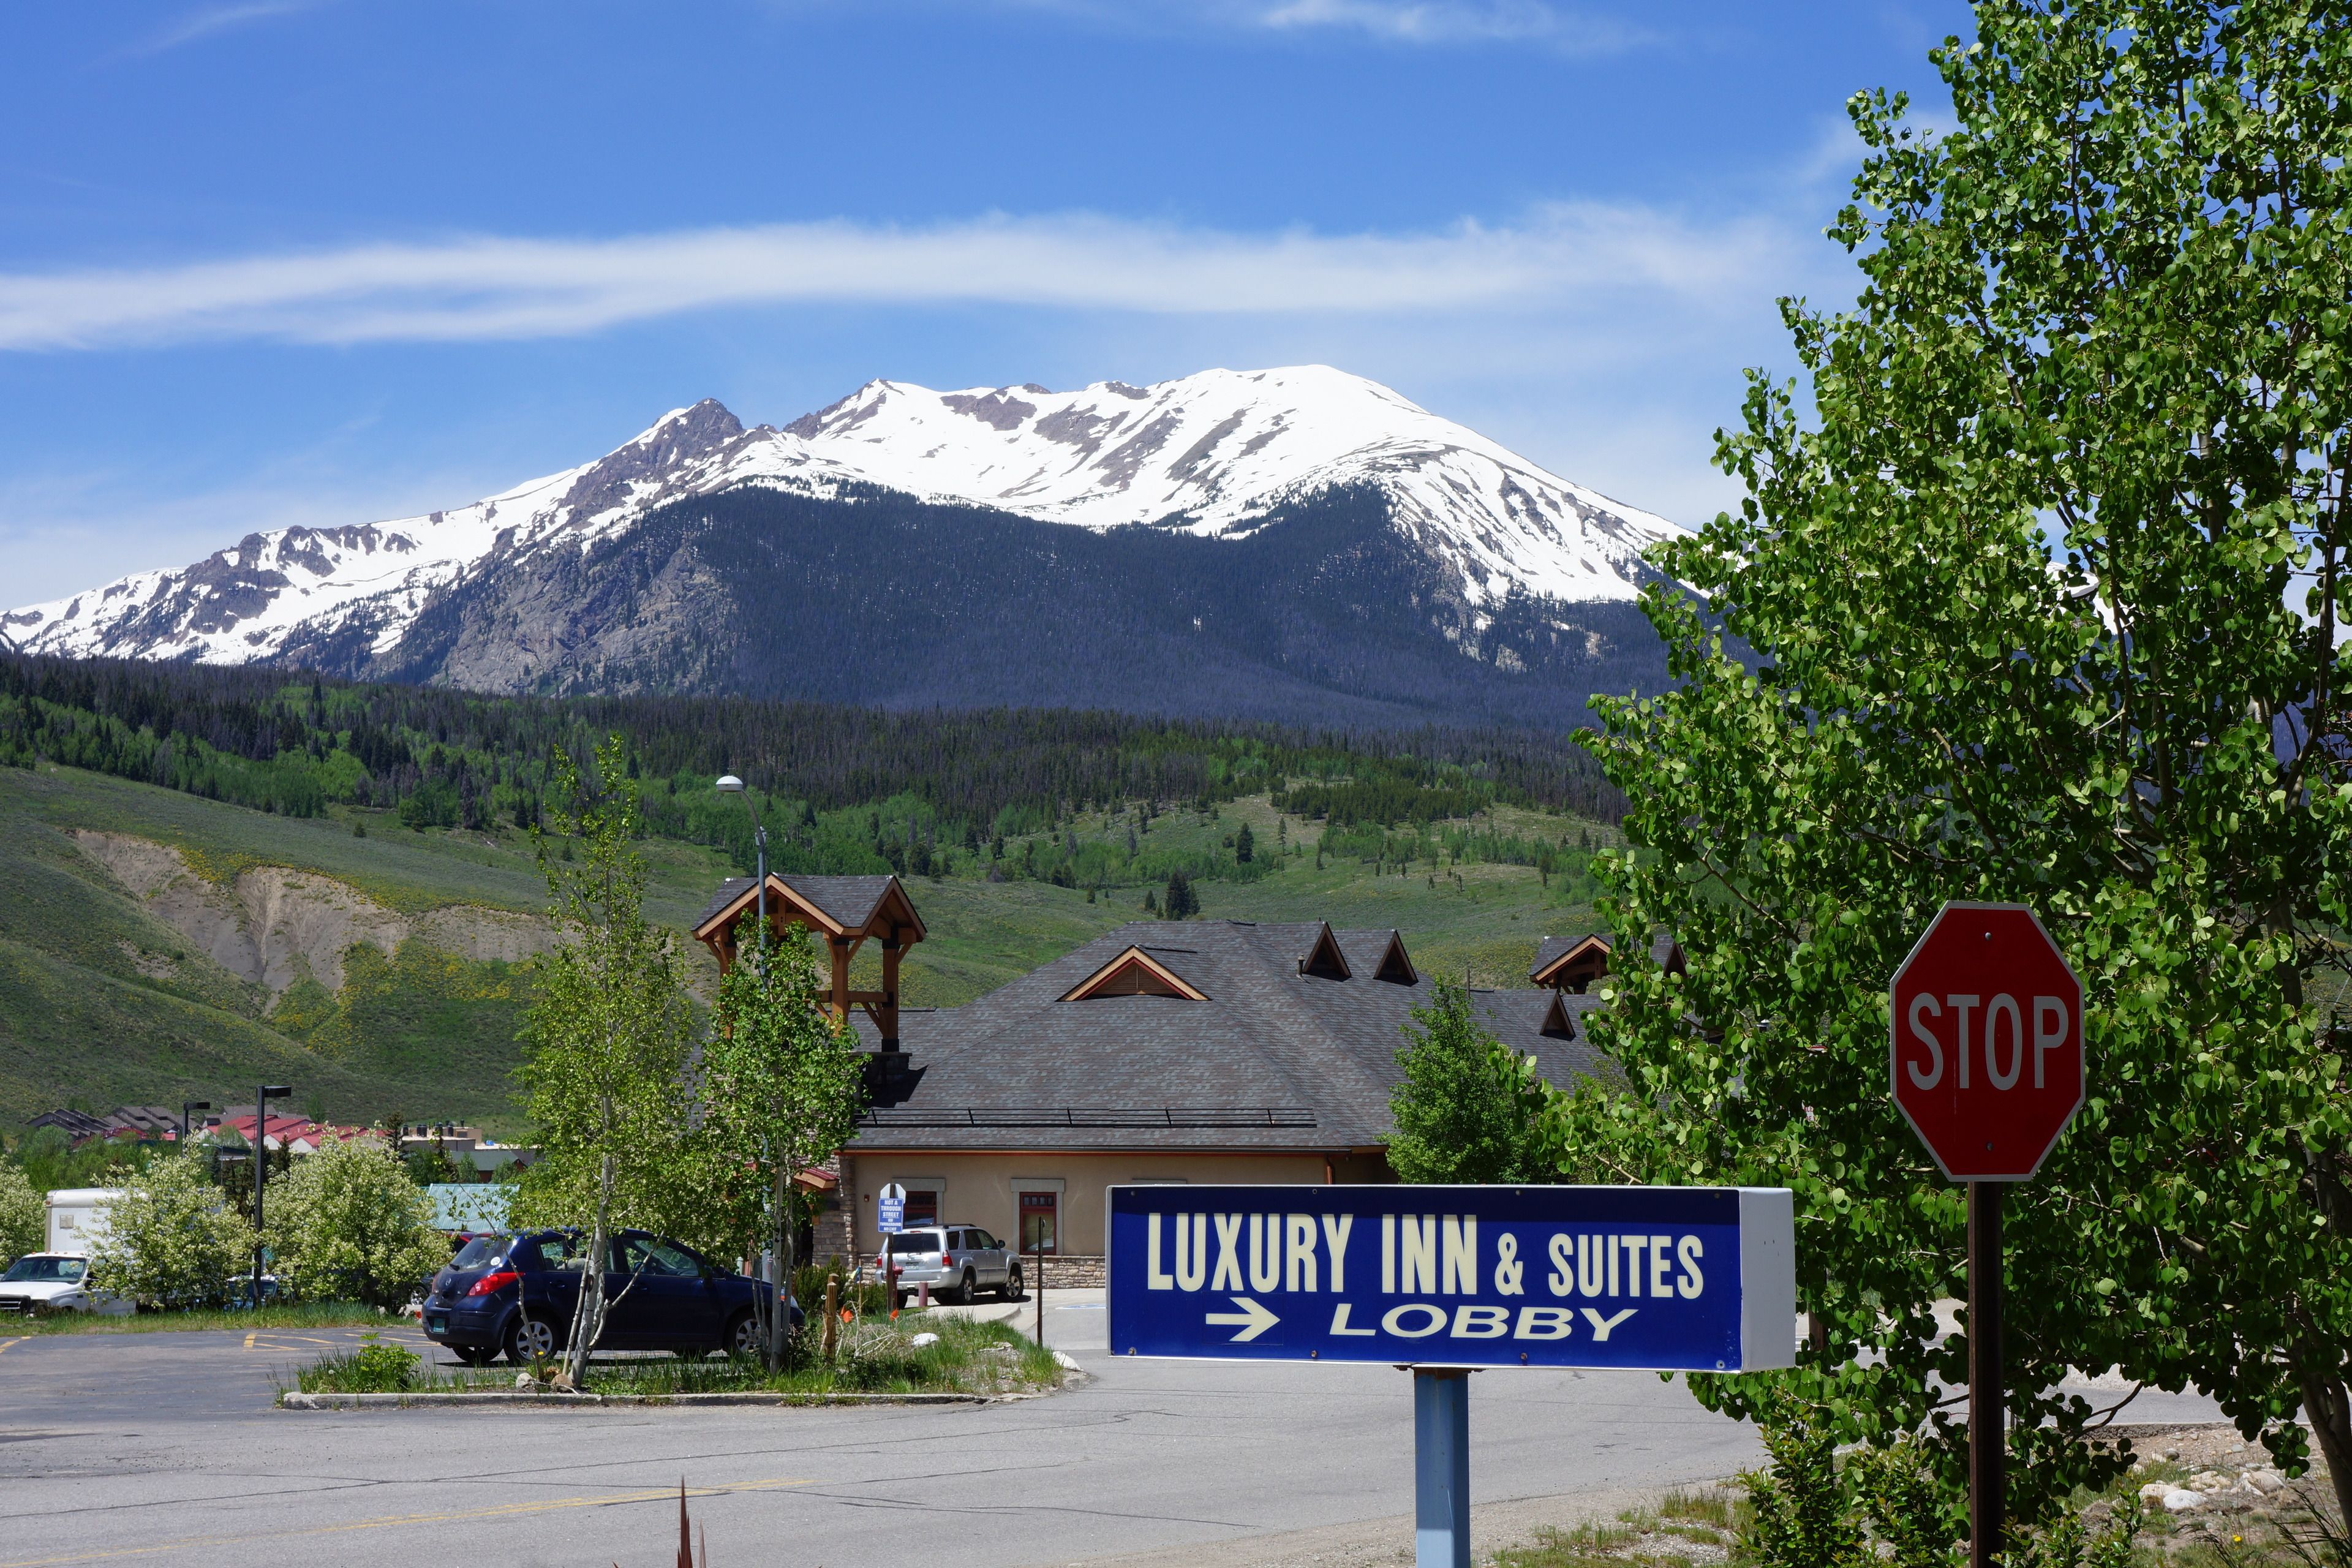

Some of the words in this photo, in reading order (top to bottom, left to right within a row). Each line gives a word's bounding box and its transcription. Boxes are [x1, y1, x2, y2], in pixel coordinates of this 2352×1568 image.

[1907, 992, 2069, 1091] STOP
[1148, 1214, 1353, 1292] LUXURY
[1382, 1216, 1477, 1295] INN
[1494, 1232, 1525, 1296] &
[1548, 1233, 1703, 1299] SUITES
[1329, 1303, 1638, 1341] LOBBY
